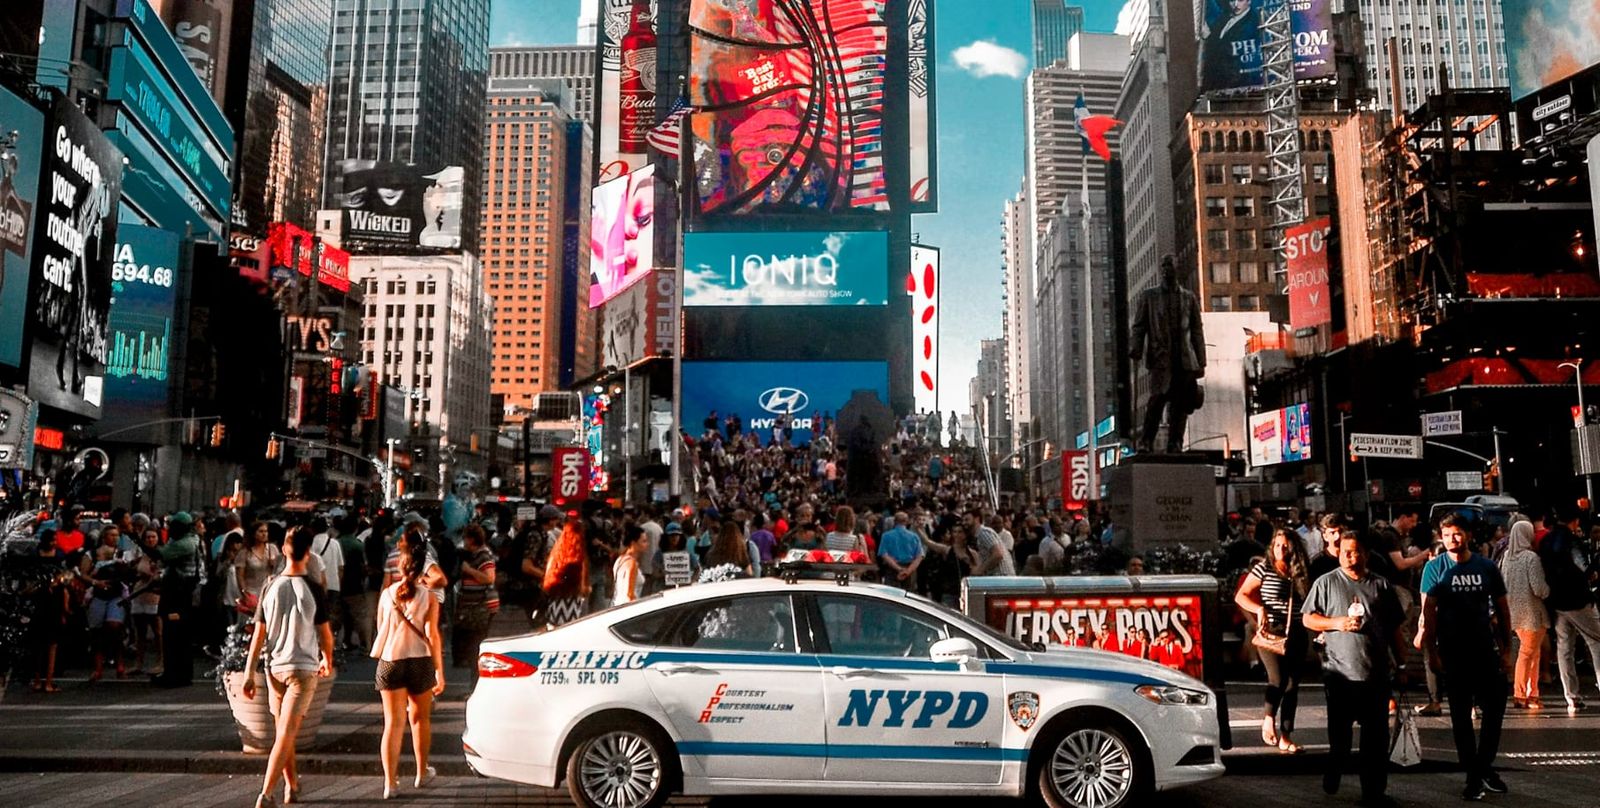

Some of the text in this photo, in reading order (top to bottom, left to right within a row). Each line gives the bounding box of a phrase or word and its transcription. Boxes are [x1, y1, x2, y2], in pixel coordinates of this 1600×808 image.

[1231, 29, 1329, 56] PHOM
[621, 94, 656, 110] Bud
[56, 125, 72, 164] Go
[51, 170, 77, 209] your
[47, 211, 83, 258] routine
[43, 254, 73, 293] can't.
[112, 262, 173, 288] 694.68
[730, 254, 837, 285] IONIQ
[808, 290, 828, 298] AUTO
[829, 290, 852, 298] SHOW
[751, 417, 812, 430] HYDA
[1353, 436, 1413, 447] PEDESTRIAN FLOW ZONE
[1380, 446, 1413, 456] KEEP MOVING
[561, 452, 585, 498] tkts
[1156, 496, 1193, 506] GEORGE
[1159, 514, 1193, 522] COHAN
[1451, 574, 1482, 586] ANU
[538, 650, 648, 670] TRAFFIC
[540, 671, 564, 685] 7759
[577, 671, 596, 685] SPL
[600, 671, 620, 685] OPS
[837, 689, 990, 729] NYPD
